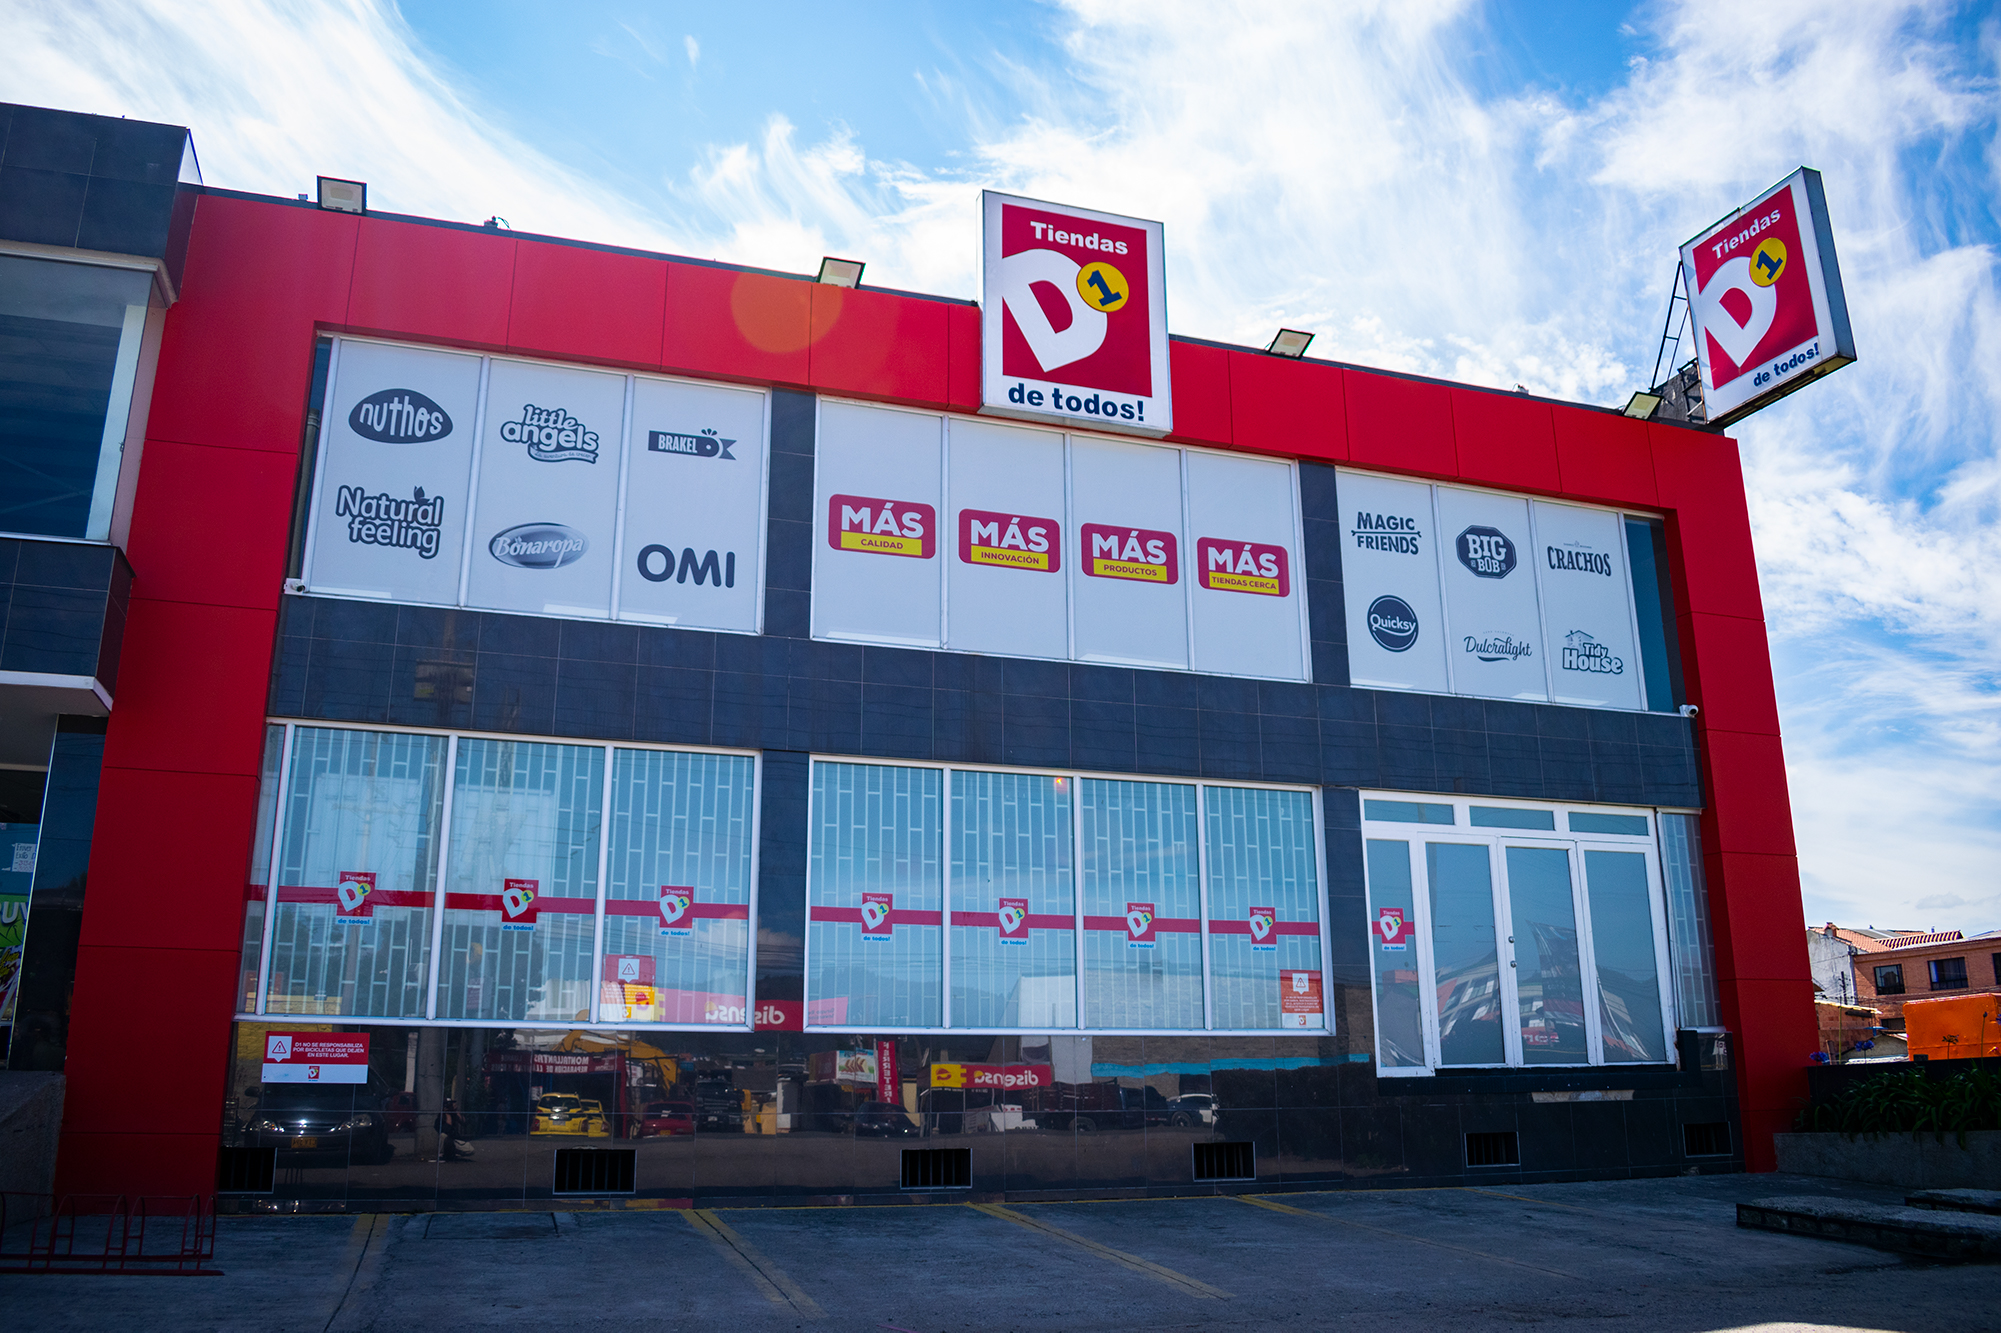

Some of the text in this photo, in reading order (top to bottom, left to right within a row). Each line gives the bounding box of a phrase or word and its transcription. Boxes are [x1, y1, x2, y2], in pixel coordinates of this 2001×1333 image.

[1030, 221, 1128, 255] Tiendas
[1712, 208, 1781, 259] Tiendas
[1754, 342, 1819, 387] de todos!
[359, 395, 444, 438] nuthos
[523, 404, 578, 431] little
[1008, 383, 1144, 422] de todos!
[500, 421, 599, 453] angels
[658, 434, 698, 454] BRAKEL
[336, 485, 444, 527] Natural
[841, 502, 924, 539] MÁS
[1357, 511, 1415, 531] MAGIC
[349, 517, 440, 559] feeling
[860, 538, 904, 550] CALIDAD
[971, 517, 1050, 553] MÁS
[1092, 530, 1167, 565] MÁS
[1357, 535, 1419, 556] FRIENDS
[1466, 533, 1507, 561] BIG
[495, 537, 584, 569] Bonaropa
[637, 543, 735, 588] OMI
[980, 551, 1040, 565] INNOVACIÓN
[1207, 545, 1279, 578] MÁS
[1477, 557, 1501, 573] BOB
[1547, 545, 1612, 577] CRACHOS
[1103, 564, 1157, 577] PRODUCTOS
[1212, 576, 1277, 590] TIENDAS CERCA
[1370, 613, 1417, 635] Quicksy
[1463, 636, 1532, 661] Dulcralight
[1562, 647, 1623, 675] House
[1583, 642, 1609, 658] Tidy
